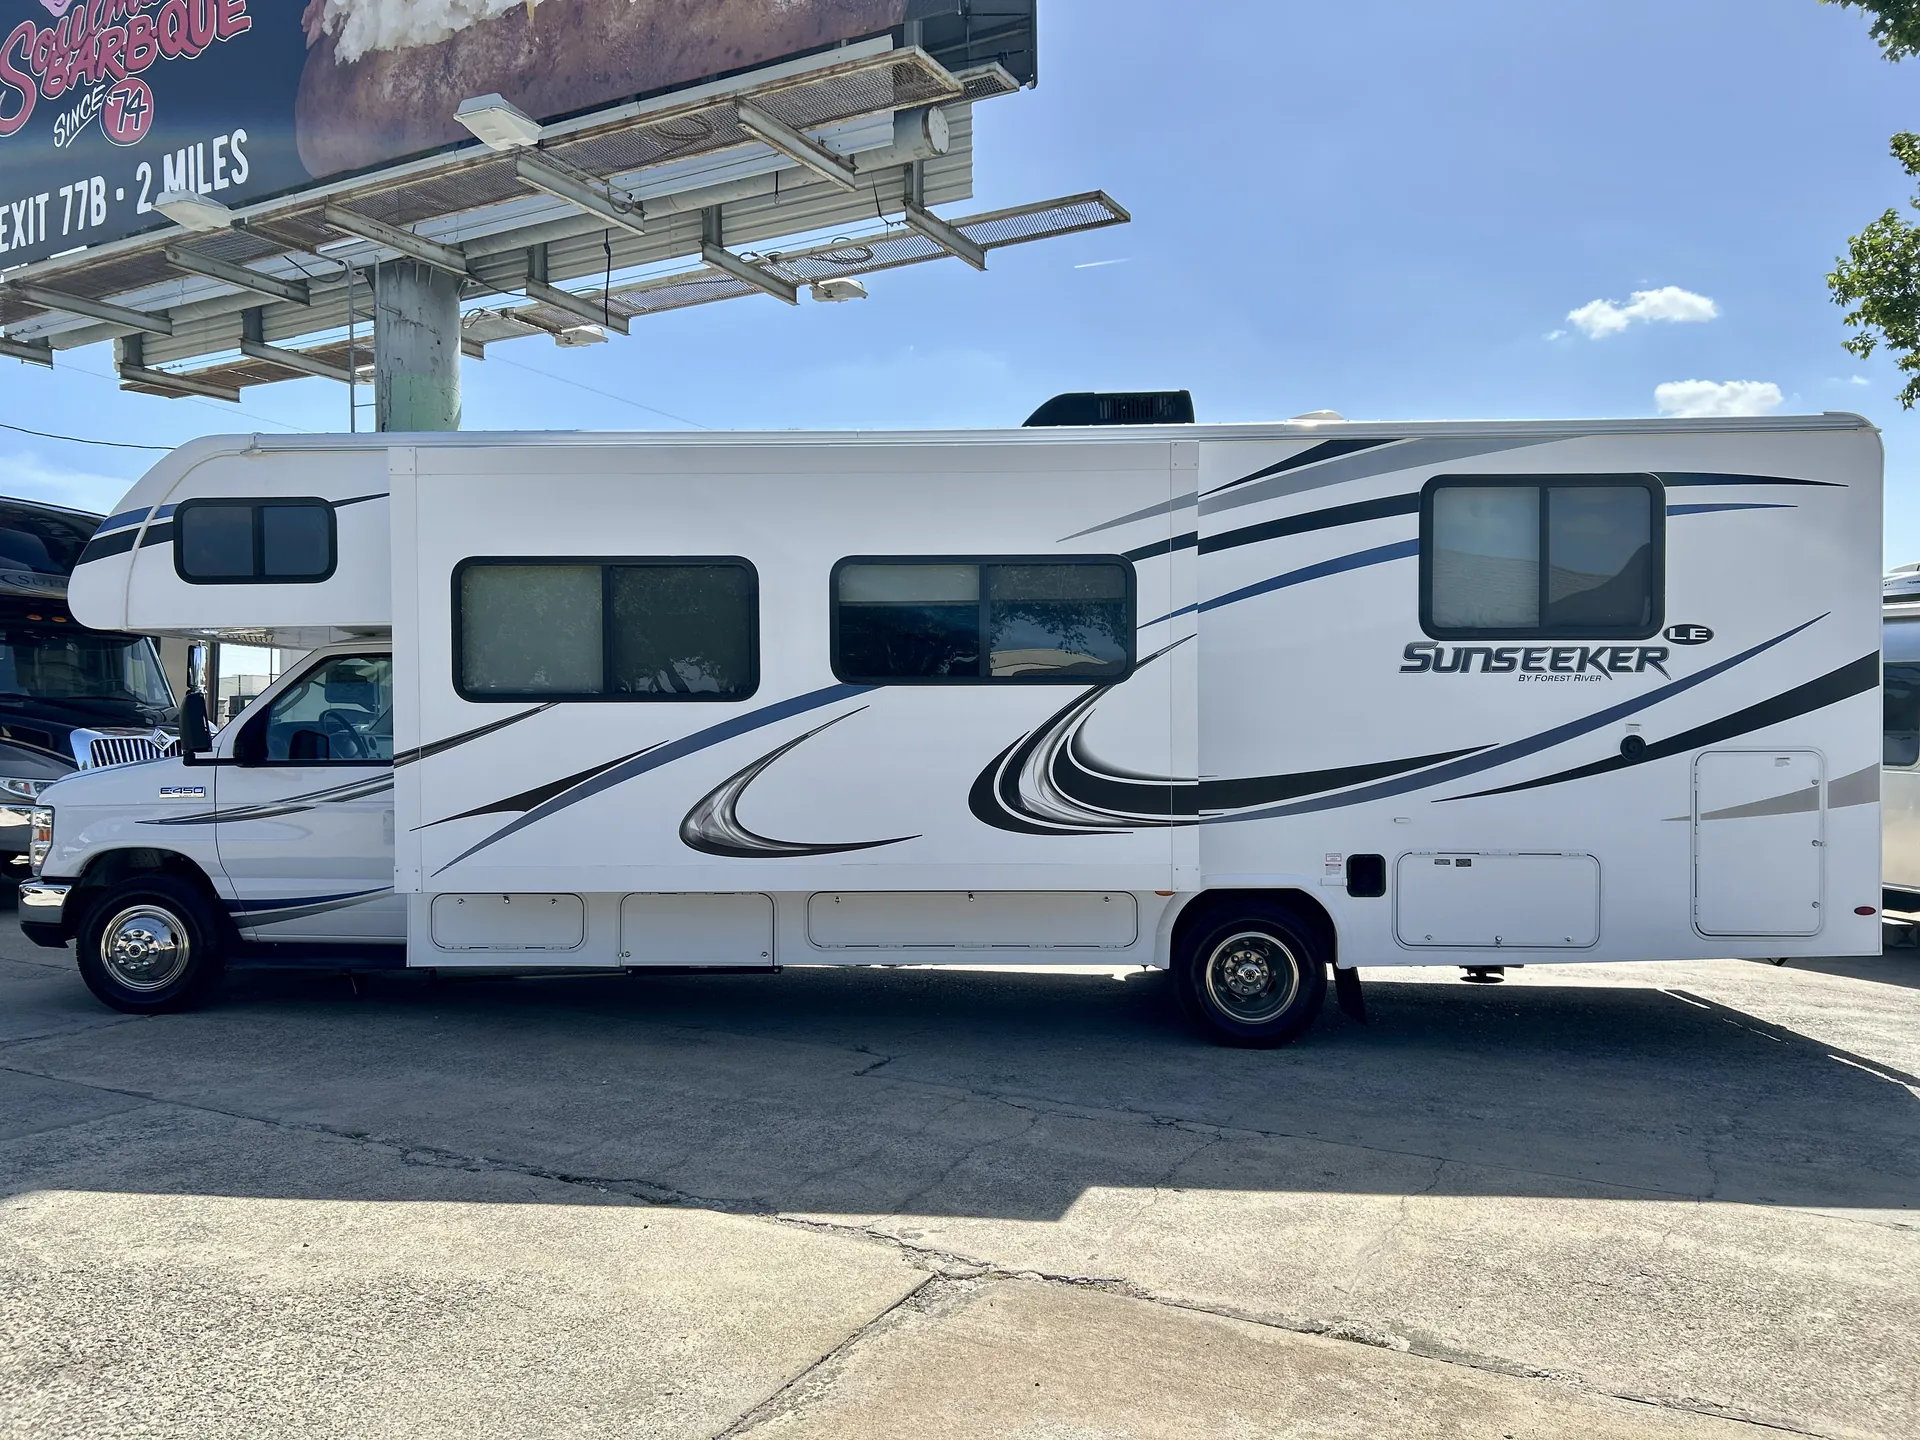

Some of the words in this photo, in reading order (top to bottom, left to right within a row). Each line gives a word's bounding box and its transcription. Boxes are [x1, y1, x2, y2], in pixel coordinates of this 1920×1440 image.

[53, 84, 106, 148] SINCE
[0, 192, 49, 253] EXIT
[59, 175, 107, 236] 77B
[136, 161, 152, 215] 2
[163, 128, 249, 195] MILES
[1669, 628, 1708, 640] LE
